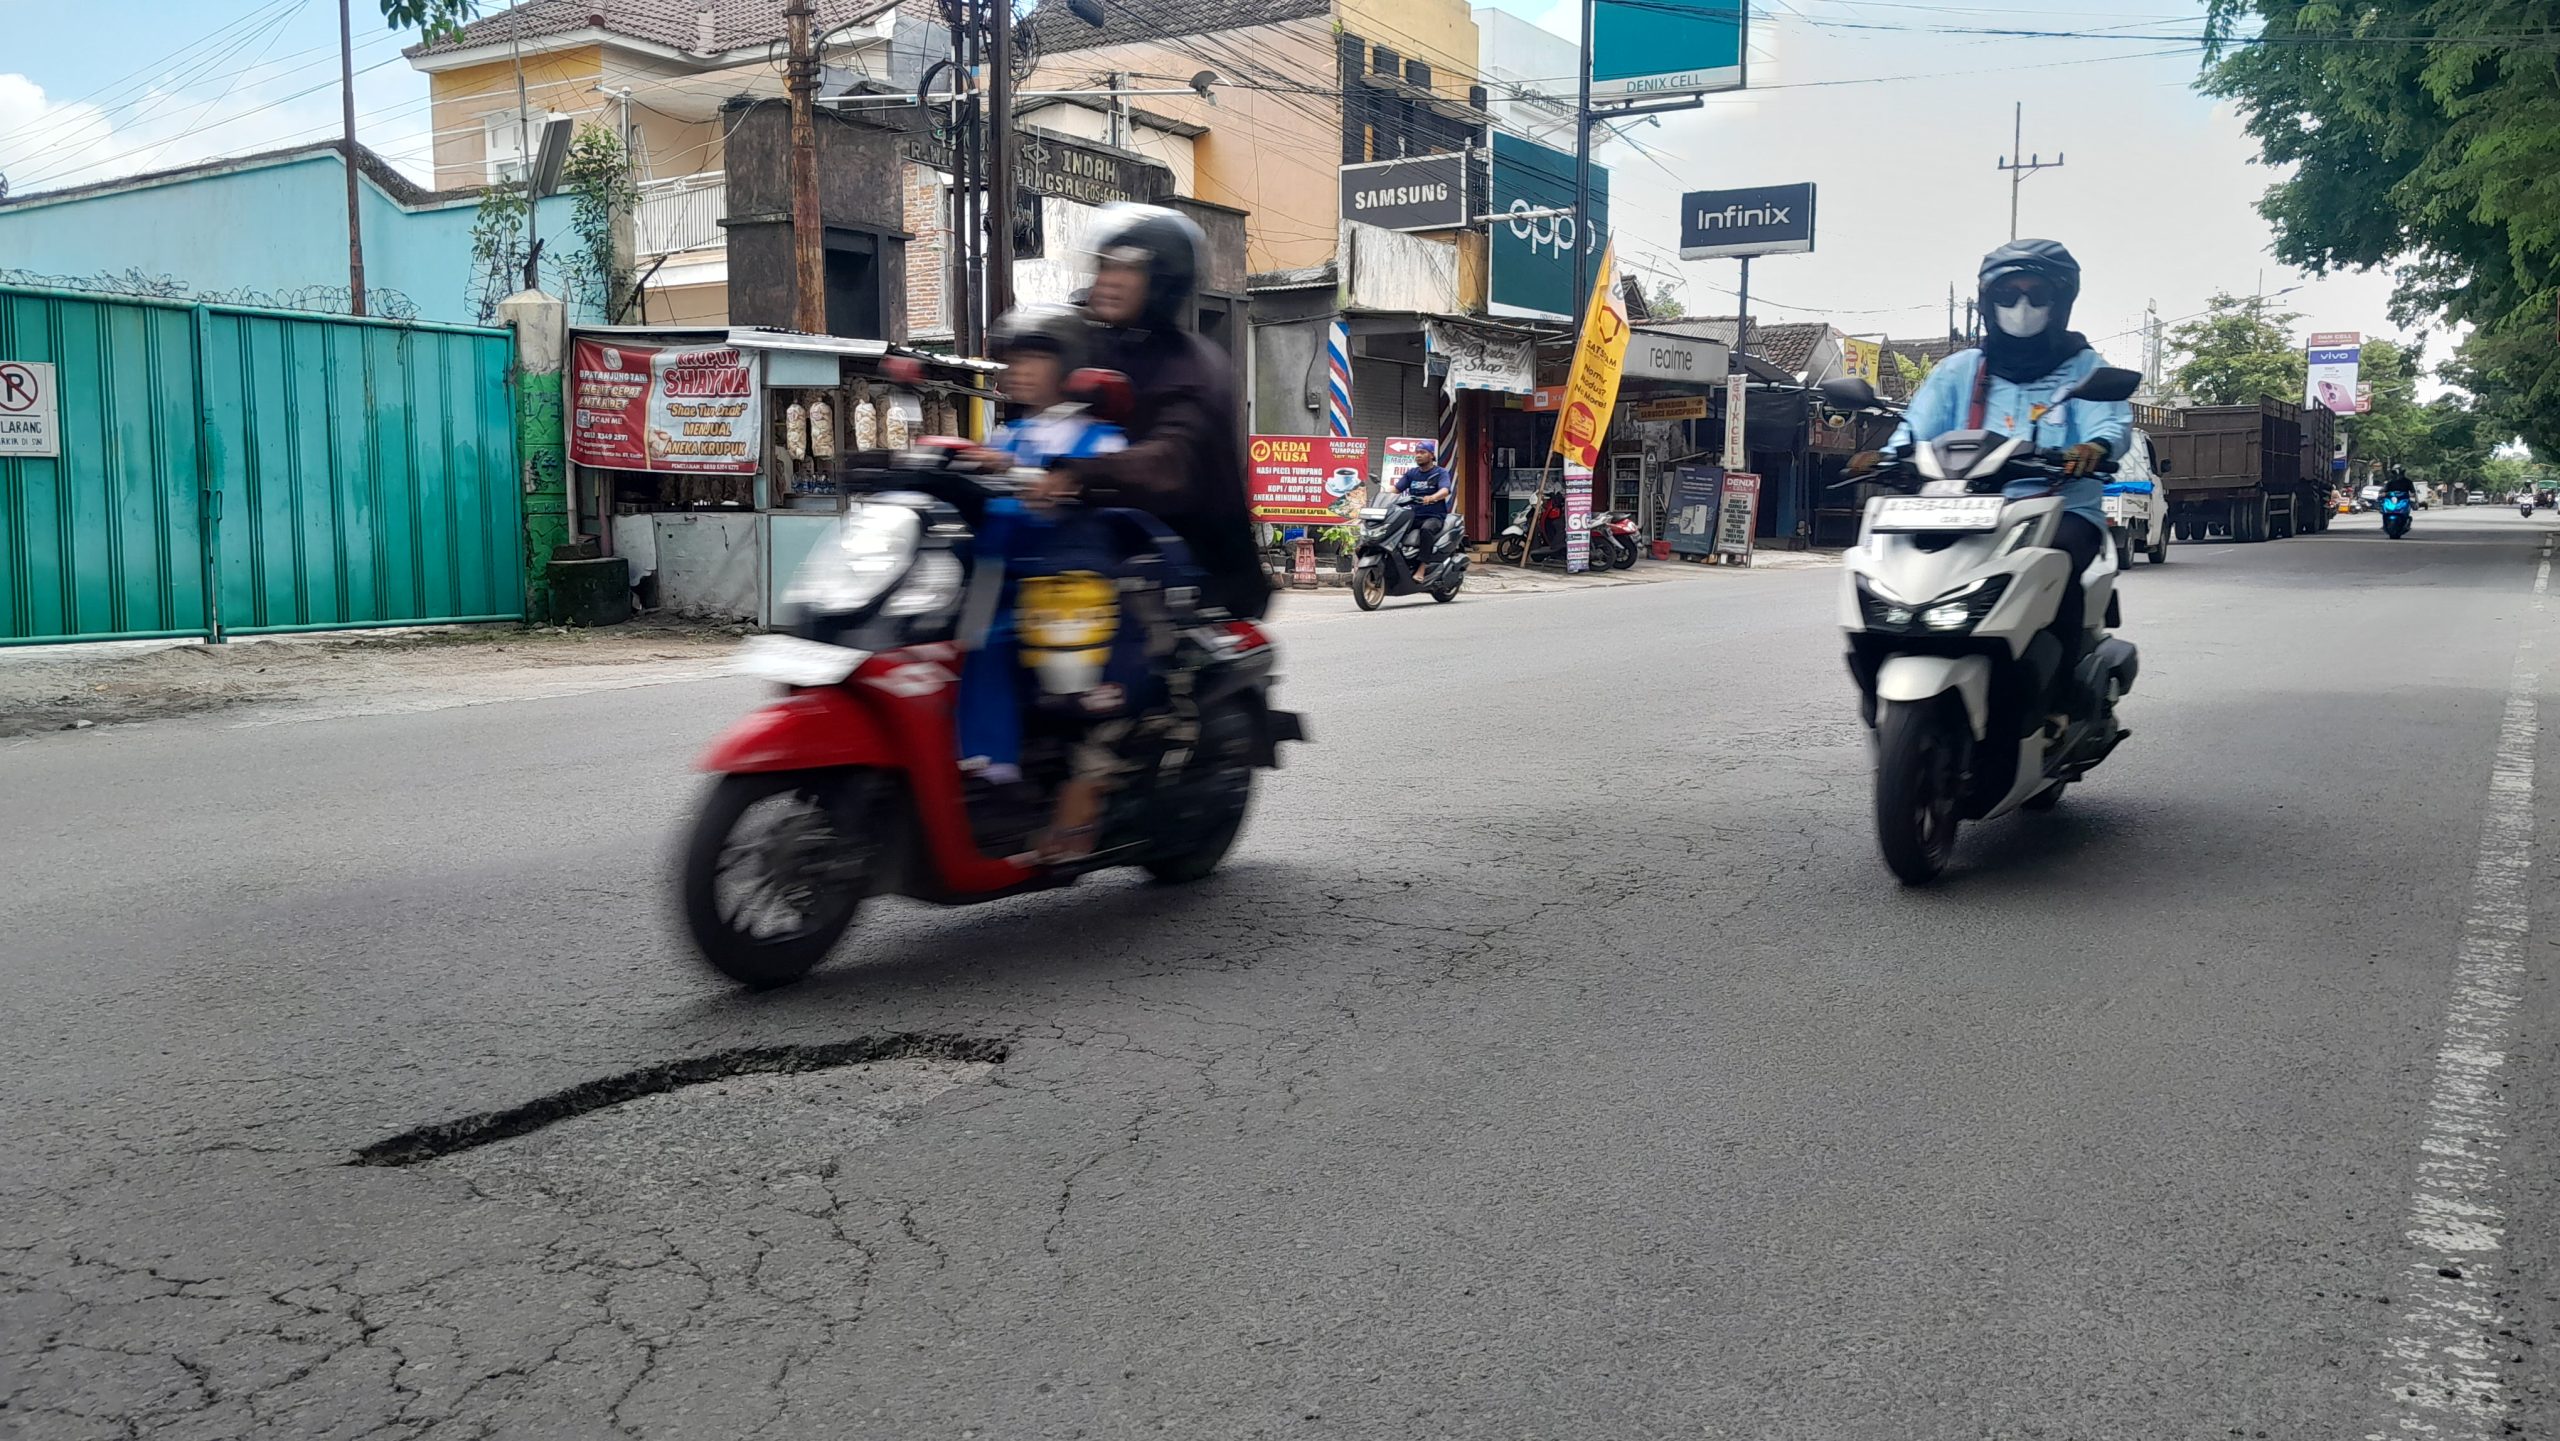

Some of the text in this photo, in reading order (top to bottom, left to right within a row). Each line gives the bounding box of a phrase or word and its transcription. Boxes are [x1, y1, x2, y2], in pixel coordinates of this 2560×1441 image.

[1627, 74, 1702, 93] DENIX CELL
[1061, 150, 1116, 183] INDAH
[1015, 165, 1083, 200] BANGSAL
[1354, 183, 1448, 210] SAMSUNG
[1697, 202, 1792, 230] Infinix
[677, 349, 740, 367] KRUPUK
[1649, 344, 1693, 371] realme
[2320, 351, 2349, 360] vivo
[1464, 357, 1503, 374] Shop
[663, 367, 751, 397] SHAYNA
[683, 422, 732, 436] MENJUAL
[664, 440, 746, 456] ANEKA KRUPUK
[1272, 441, 1311, 452] KEDAI
[1273, 452, 1309, 462] NUSA
[1256, 466, 1322, 476] NASI PECEL TUMPANG
[1288, 485, 1303, 493] KOPI
[1727, 478, 1754, 487] DENIX
